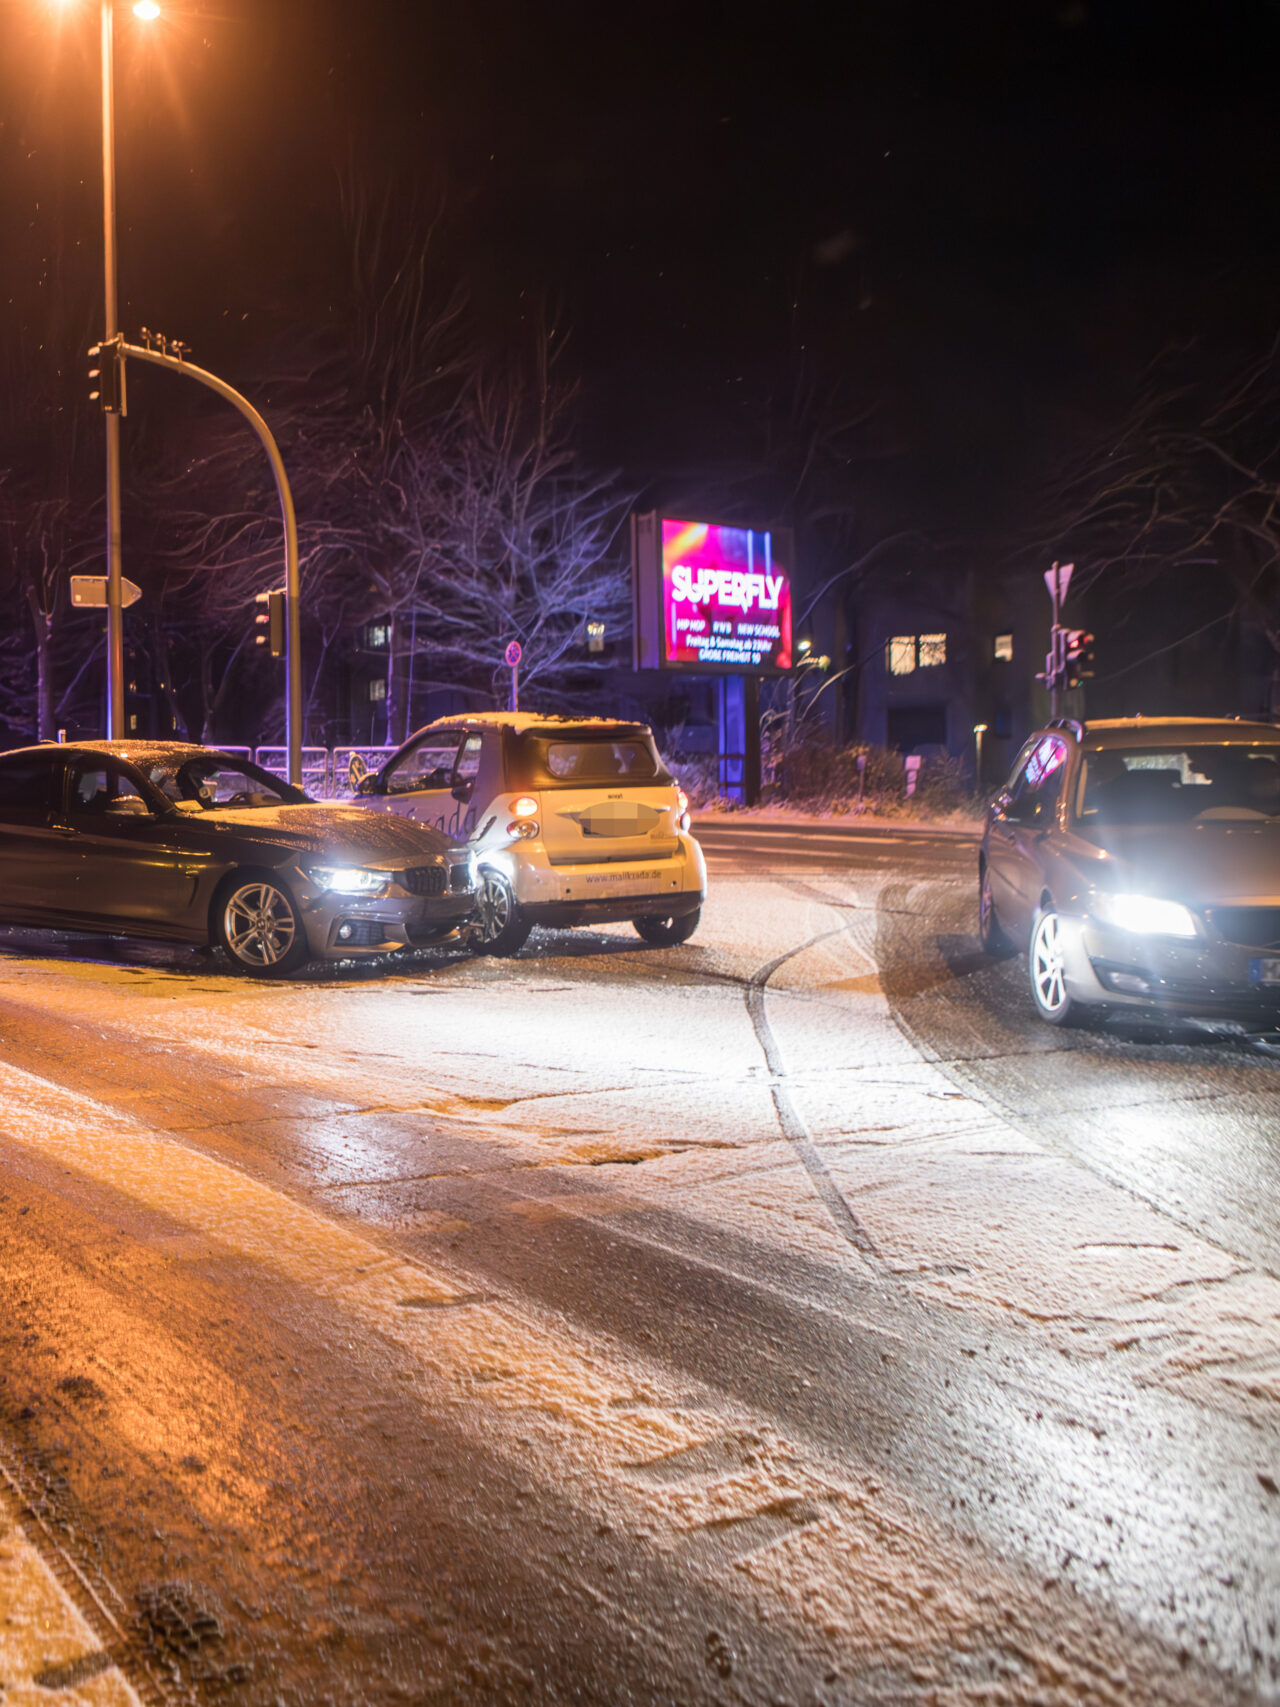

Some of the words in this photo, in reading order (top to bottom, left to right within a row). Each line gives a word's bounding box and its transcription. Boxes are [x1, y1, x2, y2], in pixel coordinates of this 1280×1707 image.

[671, 565, 784, 614] SUPERFLY
[677, 619, 690, 630] HIP
[690, 620, 705, 631] HOP
[738, 624, 754, 636] NEW
[754, 625, 780, 637] SCHOOL
